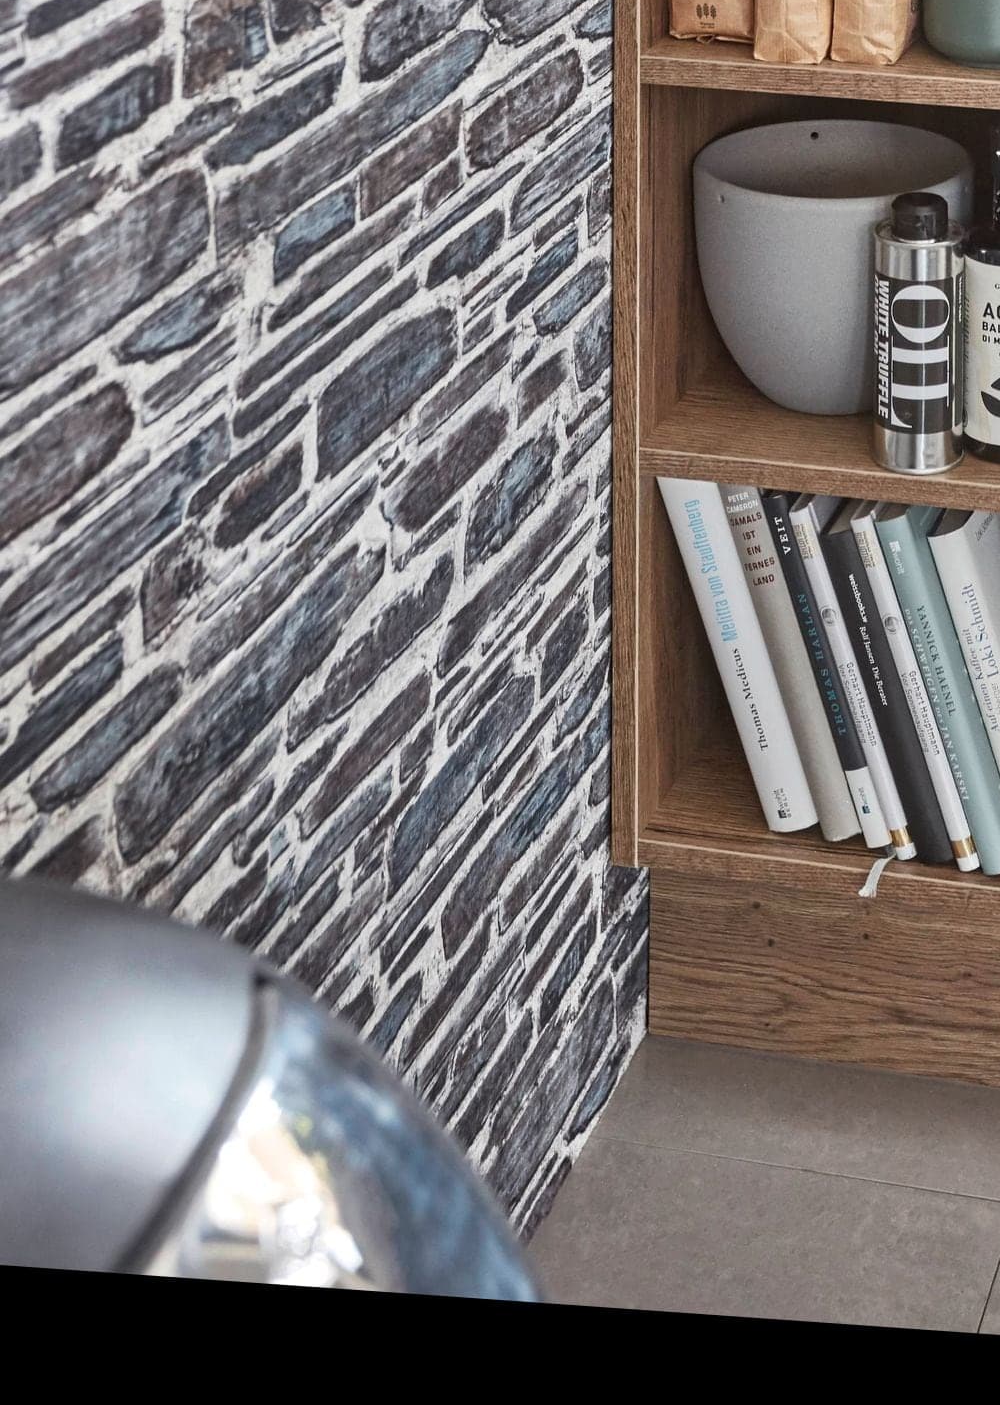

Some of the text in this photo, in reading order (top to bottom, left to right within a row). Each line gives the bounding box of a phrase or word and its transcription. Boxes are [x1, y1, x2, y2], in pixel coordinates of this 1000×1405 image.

[878, 280, 889, 419] WHITE TRUFFLE
[982, 335, 991, 343] DI
[726, 499, 758, 514] CAMERON
[727, 492, 749, 504] PETER
[729, 512, 762, 526] DAMALS
[742, 530, 756, 541] IST
[774, 515, 791, 555] VEIT
[684, 499, 740, 643] Melitta von Stauffenberg
[746, 544, 762, 556] EIN
[753, 574, 775, 587] LAND
[797, 594, 847, 735] THOMAS HARLAN
[859, 626, 888, 707] Ralf Jansen Die Berater
[917, 605, 956, 715] YANNICK HAENEL
[962, 583, 999, 679] Loki Schmidt
[733, 648, 769, 751] Thomas Medicus
[846, 662, 876, 746] Gerhart Hauptmann
[909, 671, 940, 755] Gerhart Hauptmann
[911, 628, 938, 702] SCHWEIGEN
[940, 726, 953, 749] JAN
[949, 753, 969, 800] KARSKI
[962, 628, 1000, 731] Auf einen Kaffee mit
